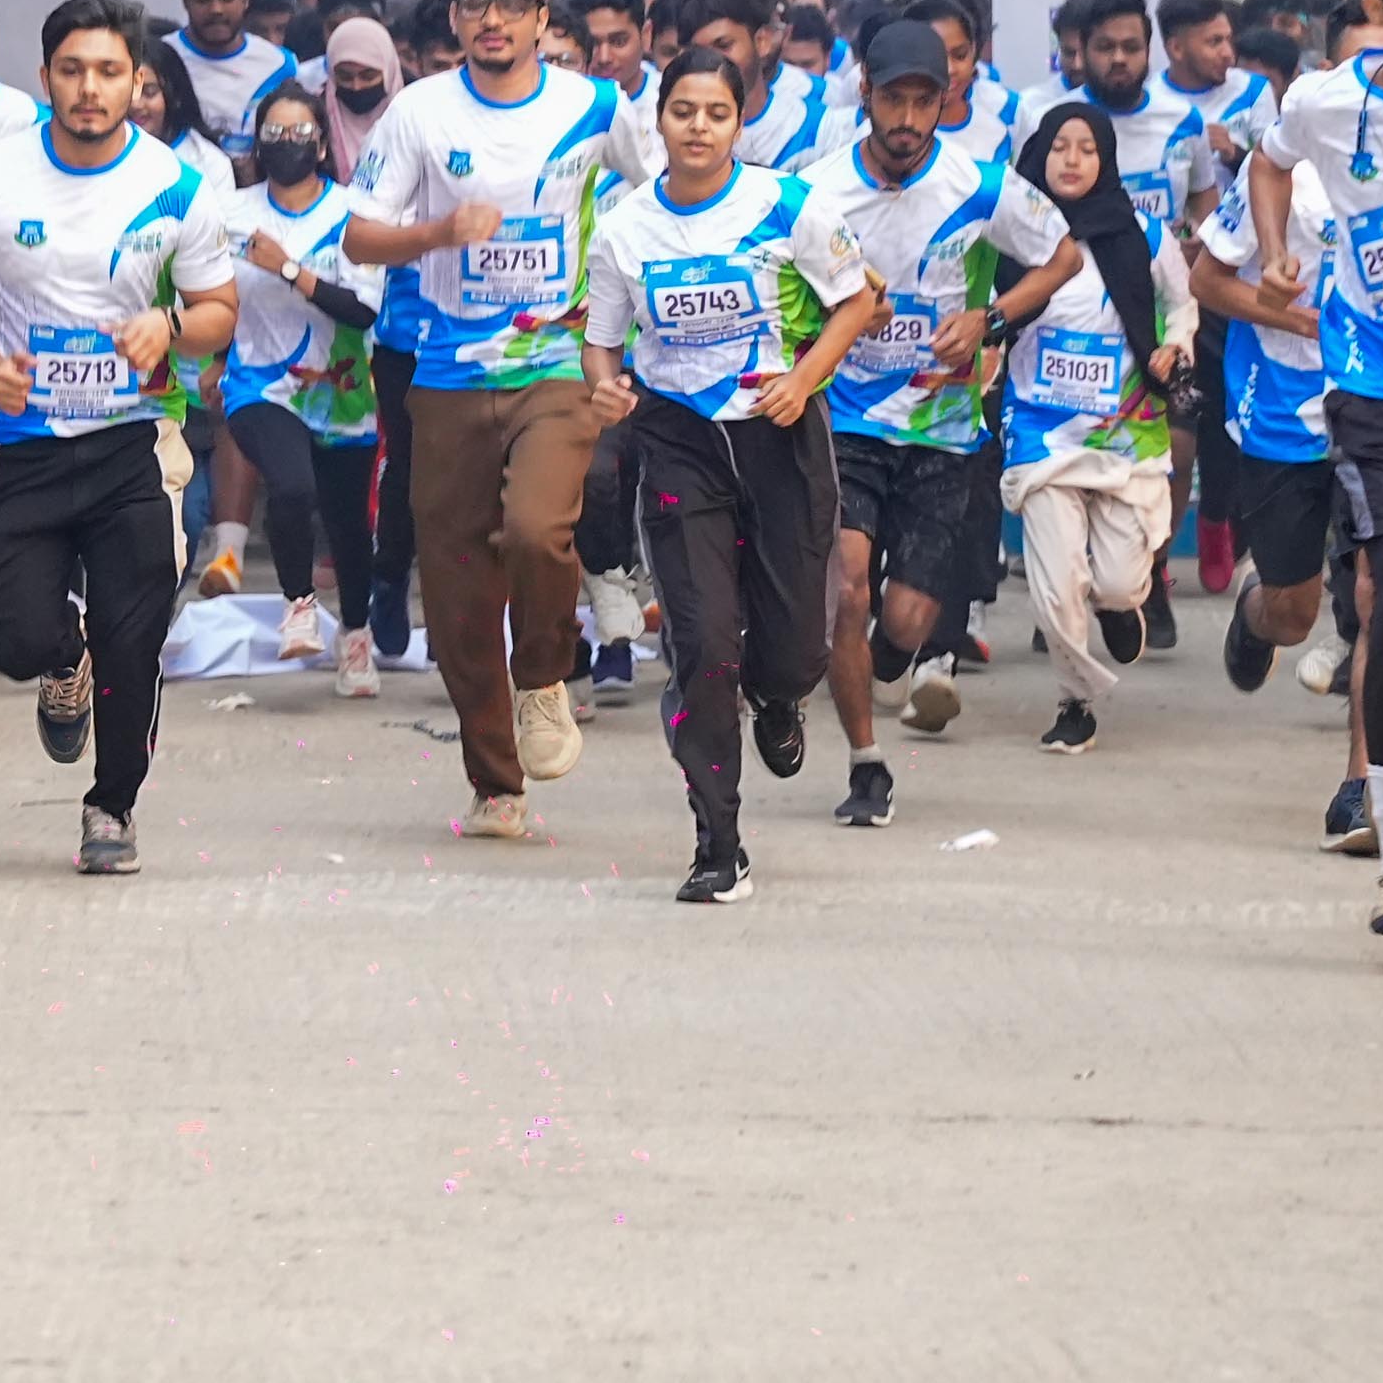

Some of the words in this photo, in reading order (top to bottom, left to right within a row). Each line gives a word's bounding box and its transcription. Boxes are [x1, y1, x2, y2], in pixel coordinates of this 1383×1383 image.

[479, 248, 547, 272] 25751
[664, 289, 741, 317] 25743
[47, 359, 117, 386] 25713
[1045, 355, 1108, 383] 251031
